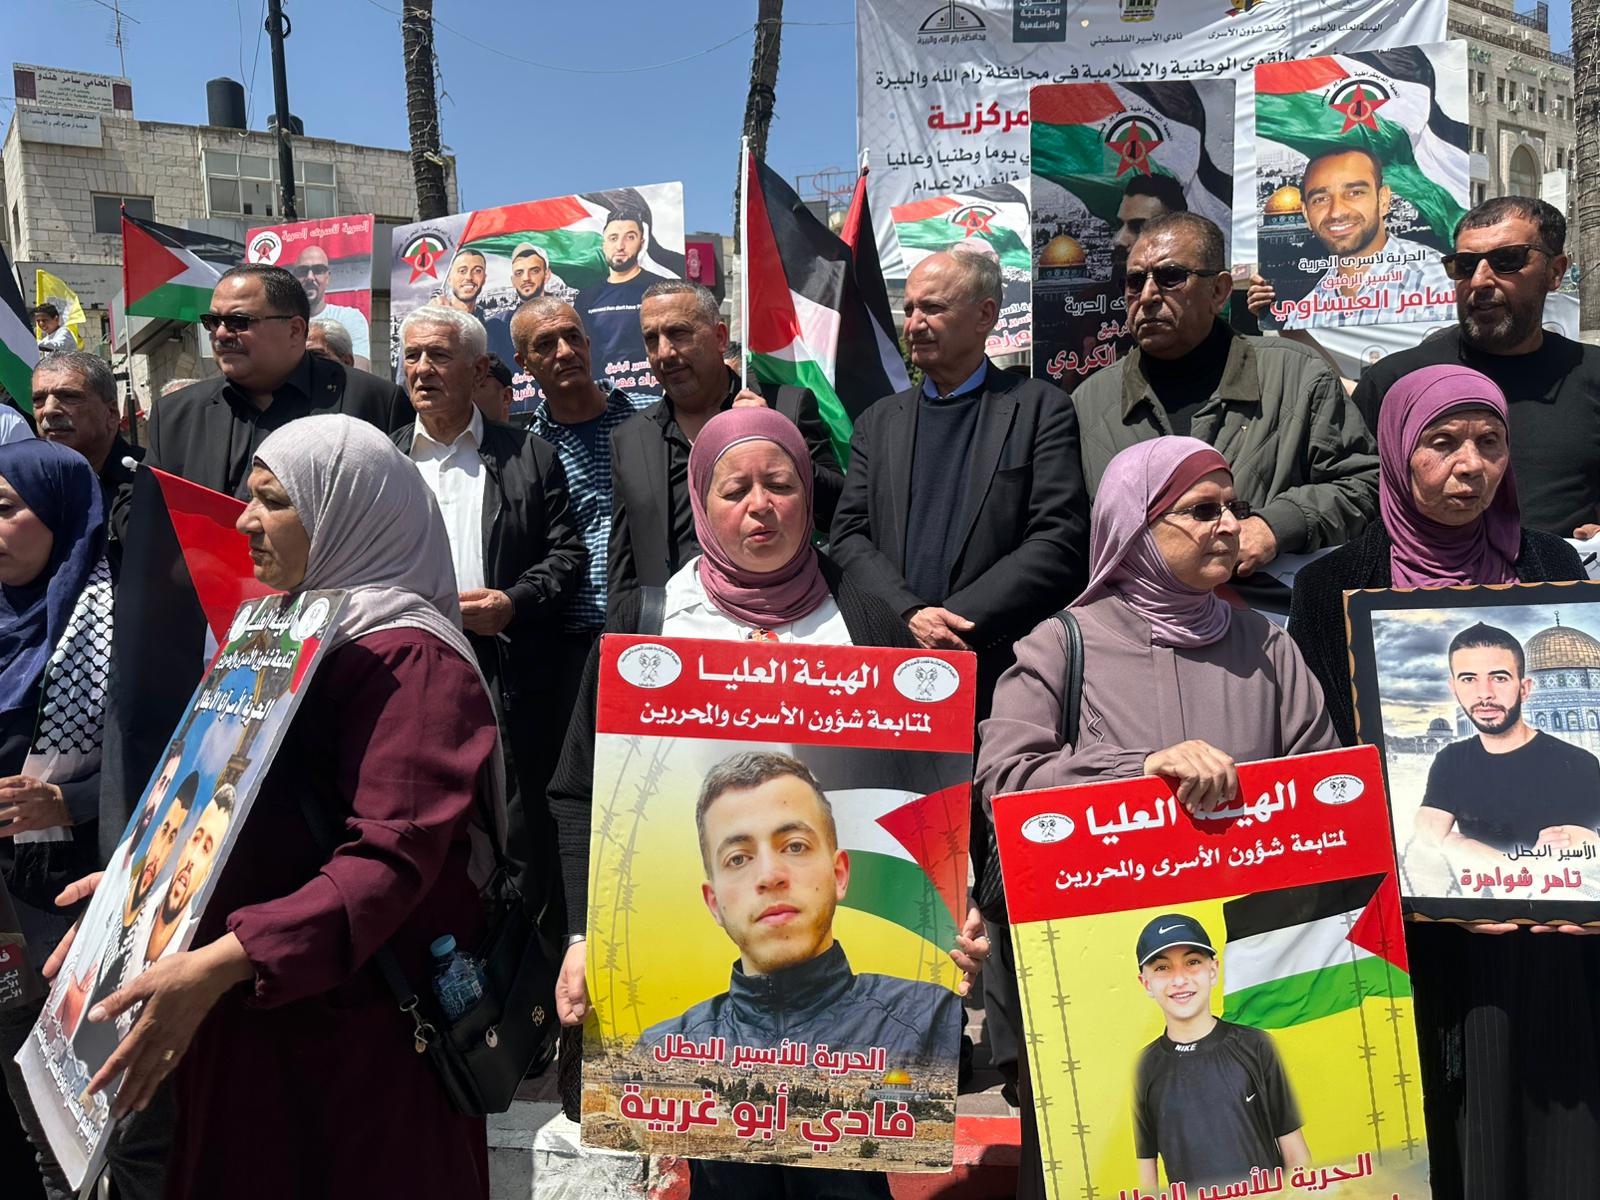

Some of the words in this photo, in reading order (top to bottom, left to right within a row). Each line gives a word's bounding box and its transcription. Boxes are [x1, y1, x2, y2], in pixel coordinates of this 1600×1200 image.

[1090, 36, 1134, 46] الفلسطيني
[1134, 32, 1162, 44] الأسير
[1208, 27, 1238, 40] الأسرى
[1240, 27, 1263, 37] شؤون
[876, 71, 928, 91] والبيرة
[932, 62, 958, 83] الله
[961, 67, 982, 84] رام
[985, 65, 1050, 80] محافظة
[1052, 64, 1079, 83] في
[1082, 62, 1168, 82] والإسلامية
[1170, 58, 1236, 79] الوطنية
[927, 101, 1030, 135] مركزية
[1298, 255, 1338, 273] الحرية
[1341, 250, 1384, 269] لأسرى
[1386, 249, 1426, 267] الحرية
[1322, 274, 1363, 290] الرفيق
[1365, 270, 1404, 287] الأسير
[1064, 294, 1107, 317] الحرية
[1270, 289, 1390, 322] العيساوي
[1098, 319, 1129, 340] رفيق
[1046, 342, 1117, 379] الكردي
[698, 654, 787, 690] العليا
[792, 657, 879, 695] الهيئة
[639, 701, 729, 726] والمحررين
[733, 700, 804, 727] الأسرى
[808, 706, 864, 733] شؤون
[867, 708, 932, 737] لمتابعة
[1085, 796, 1177, 845] العليا
[1227, 836, 1285, 867] شؤون
[1291, 829, 1348, 857] لمتابعة
[1558, 841, 1596, 861] الأسير
[1055, 858, 1146, 890] والمحررين
[1152, 845, 1221, 878] الأسرى
[654, 1033, 725, 1063] البطل
[731, 1038, 807, 1071] للأسير
[813, 1044, 886, 1075] الحرية
[1175, 1043, 1197, 1052] NIKE
[620, 1083, 718, 1133] غربية
[732, 1082, 788, 1140] أبو
[800, 1098, 916, 1152] فادي
[1290, 1152, 1373, 1192] الحرية
